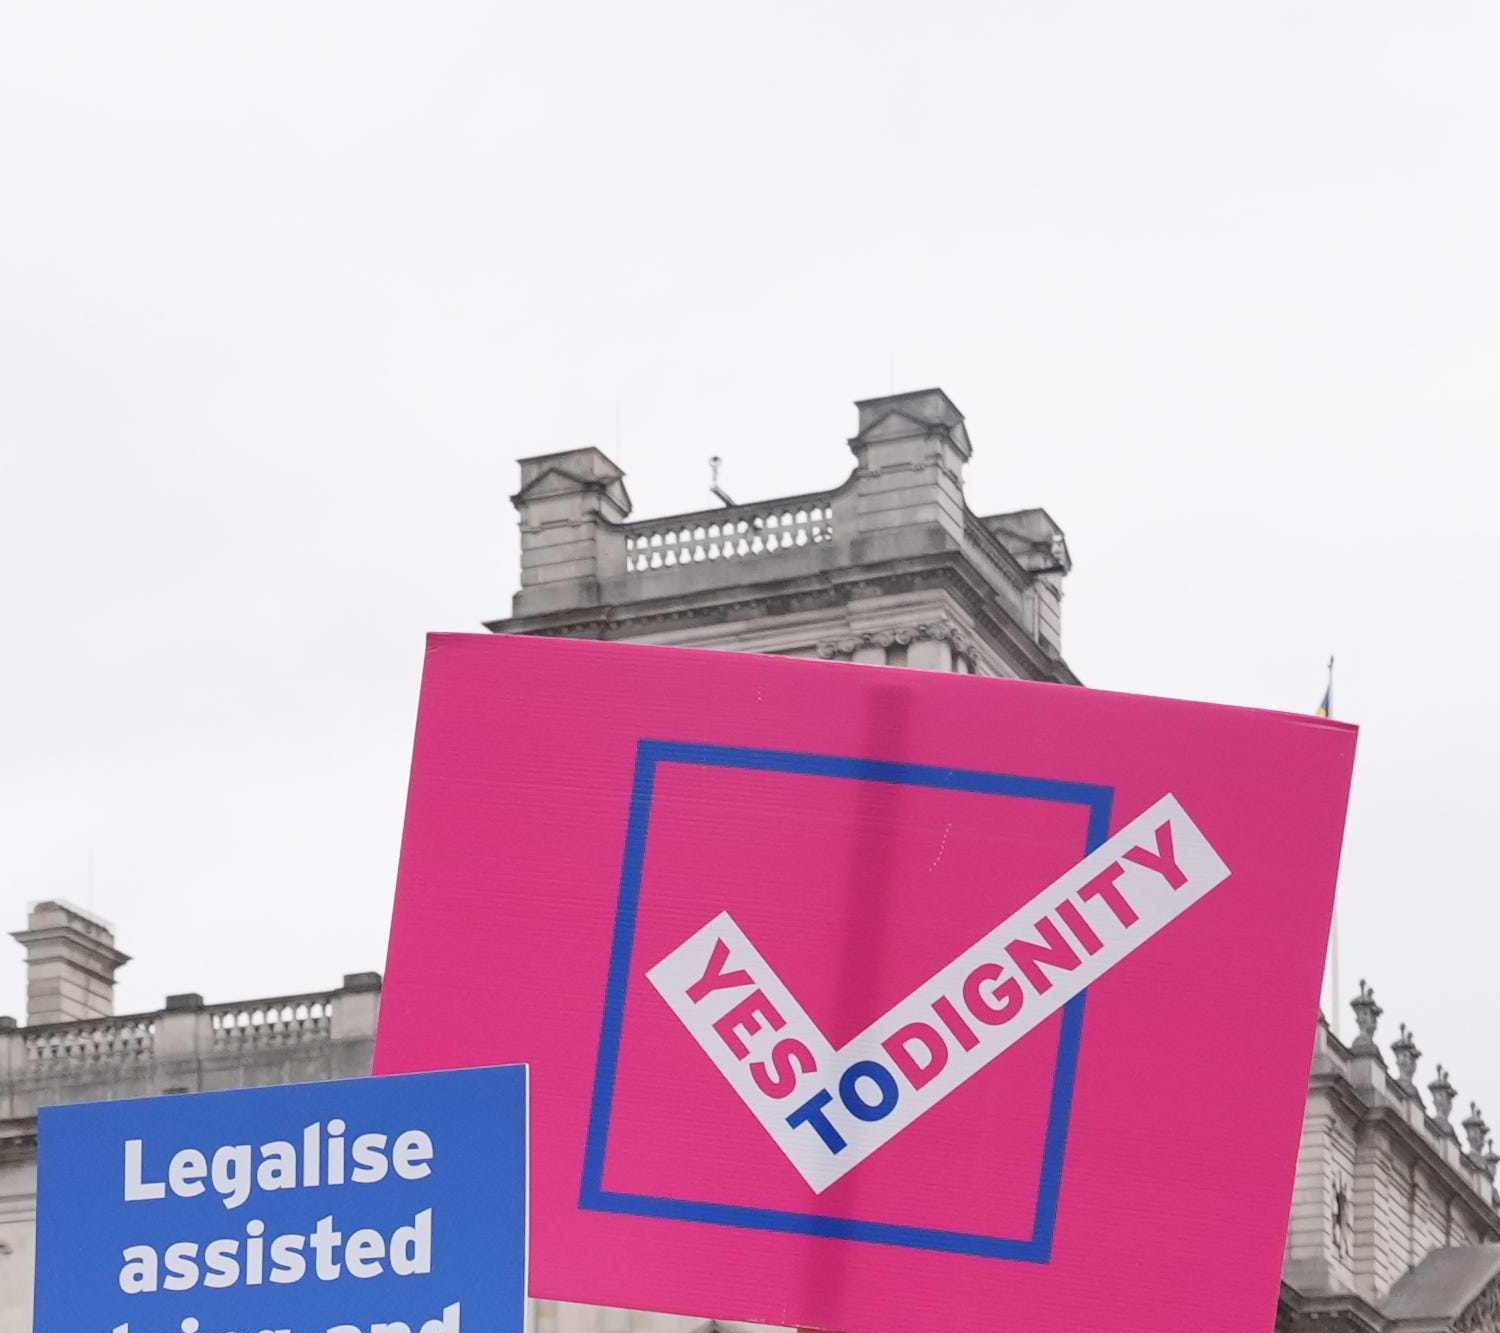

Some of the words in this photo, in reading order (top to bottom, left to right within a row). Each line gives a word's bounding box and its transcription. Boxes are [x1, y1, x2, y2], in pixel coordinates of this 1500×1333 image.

[685, 937, 816, 1100] YES
[126, 1120, 432, 1208] Legalise
[120, 1210, 431, 1293] assisted
